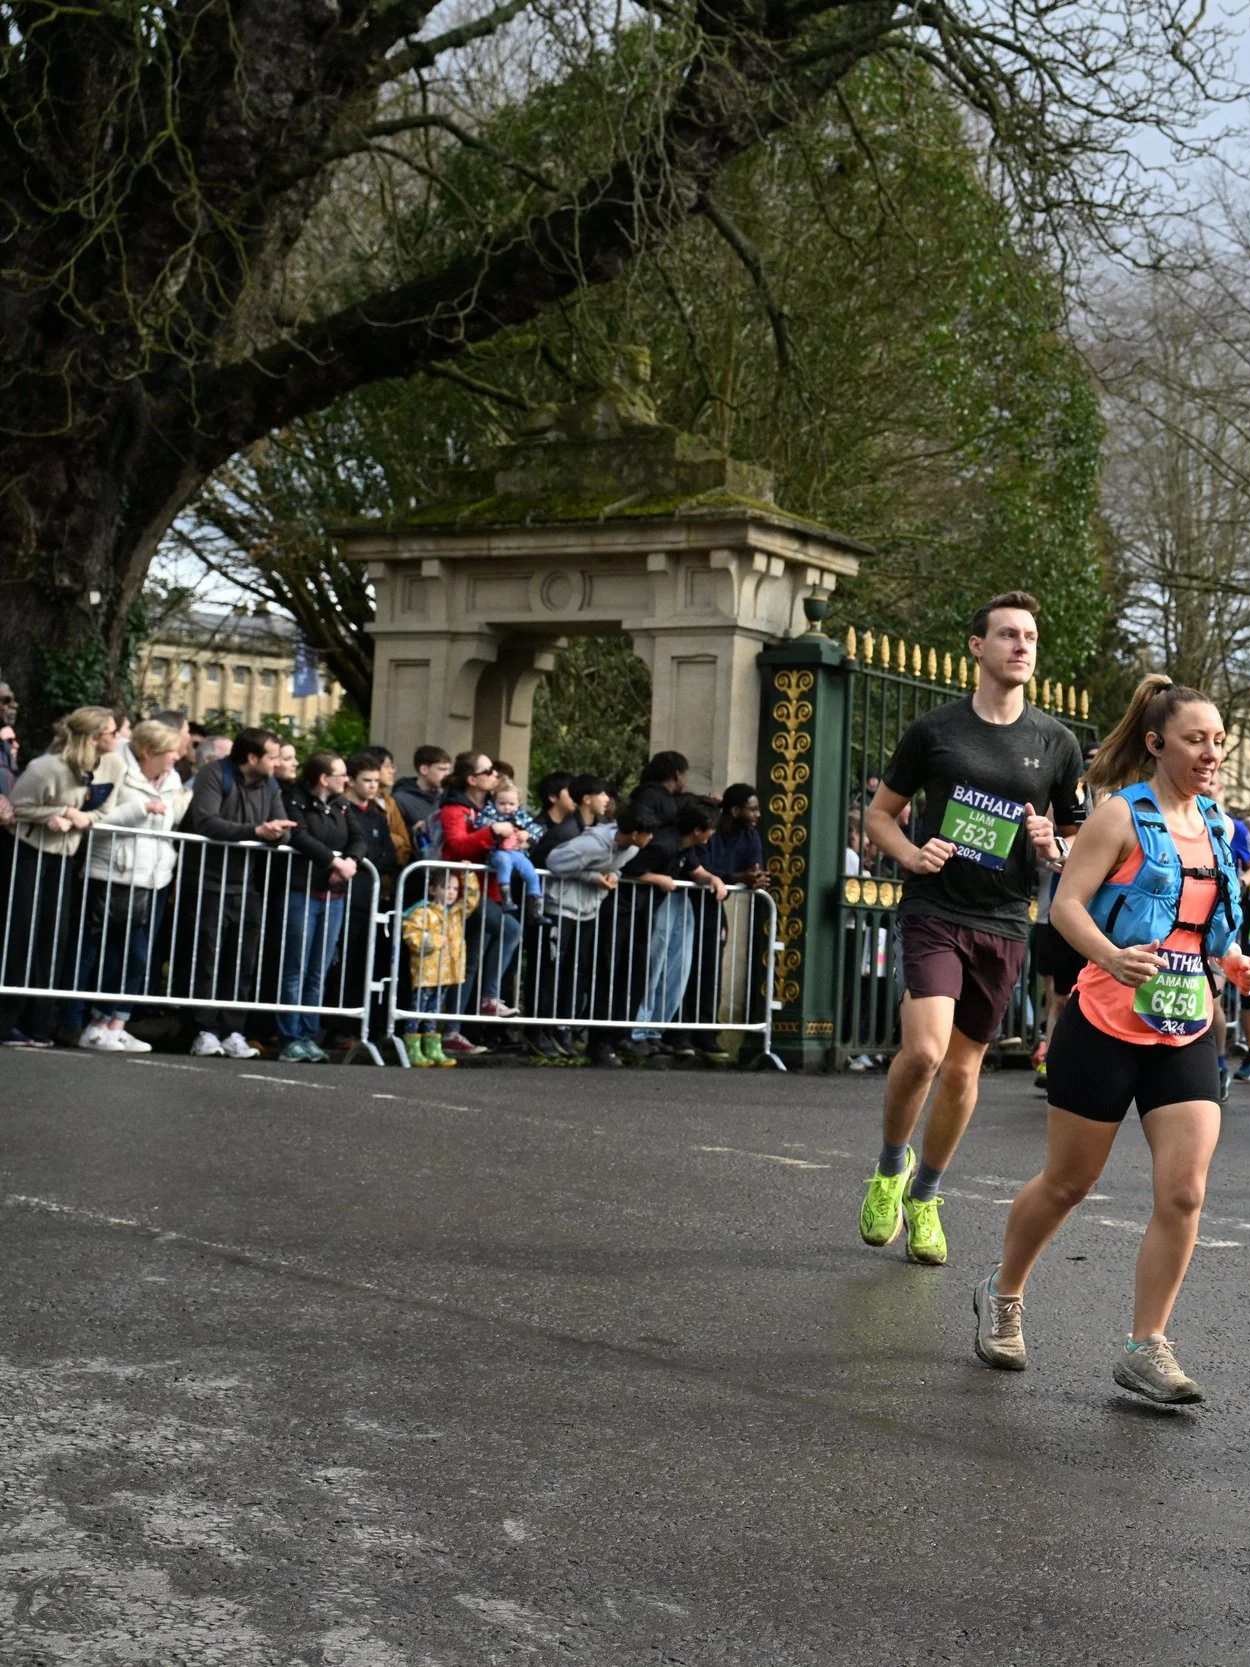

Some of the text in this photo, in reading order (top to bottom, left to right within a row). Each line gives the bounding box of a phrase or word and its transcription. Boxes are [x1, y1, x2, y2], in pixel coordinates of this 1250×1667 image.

[953, 785, 1024, 820] BATHALF
[969, 811, 996, 827] LIAM
[952, 818, 997, 850] 7523
[956, 845, 982, 862] 2024
[1151, 989, 1197, 1017] 6259
